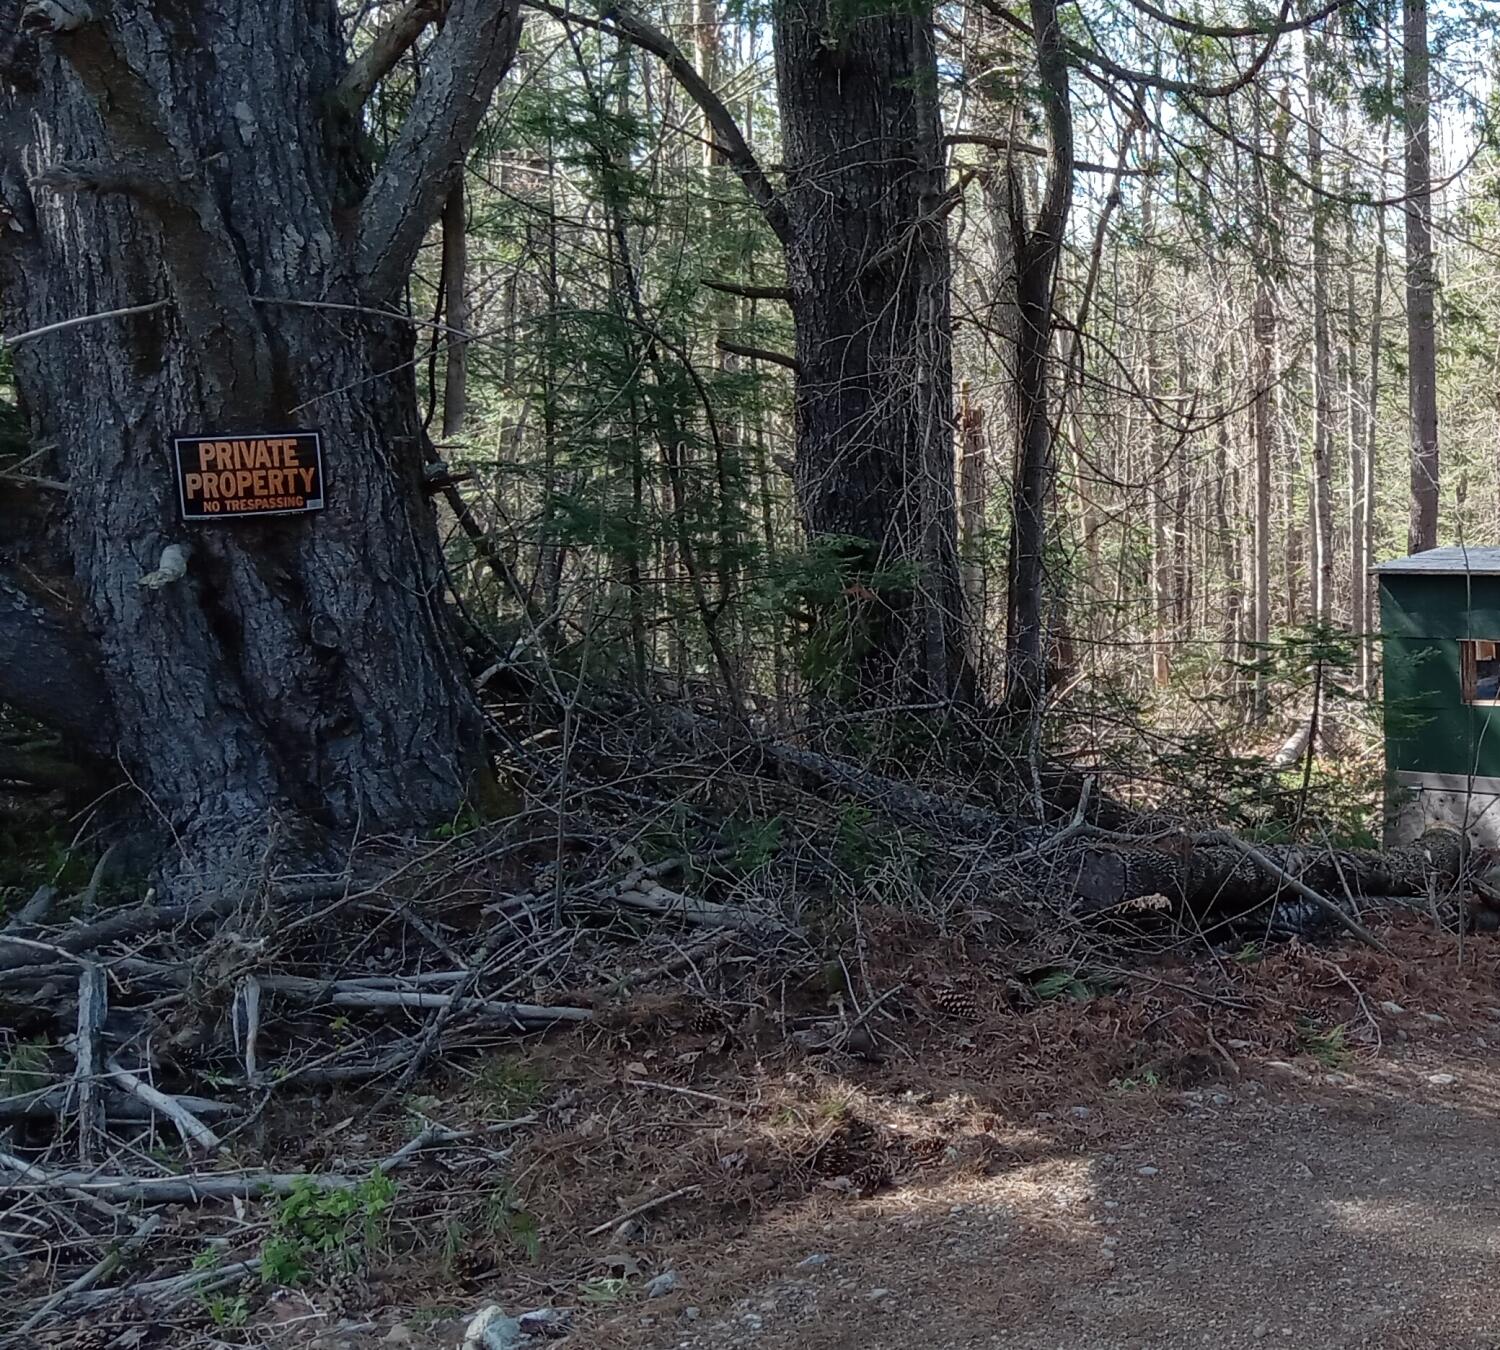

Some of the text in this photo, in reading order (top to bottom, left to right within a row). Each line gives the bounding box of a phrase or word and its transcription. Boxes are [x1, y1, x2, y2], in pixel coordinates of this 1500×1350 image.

[198, 439, 300, 471] PRIVATE
[185, 467, 315, 499] PROPERTY
[203, 496, 304, 513] NO TRESPASSING
